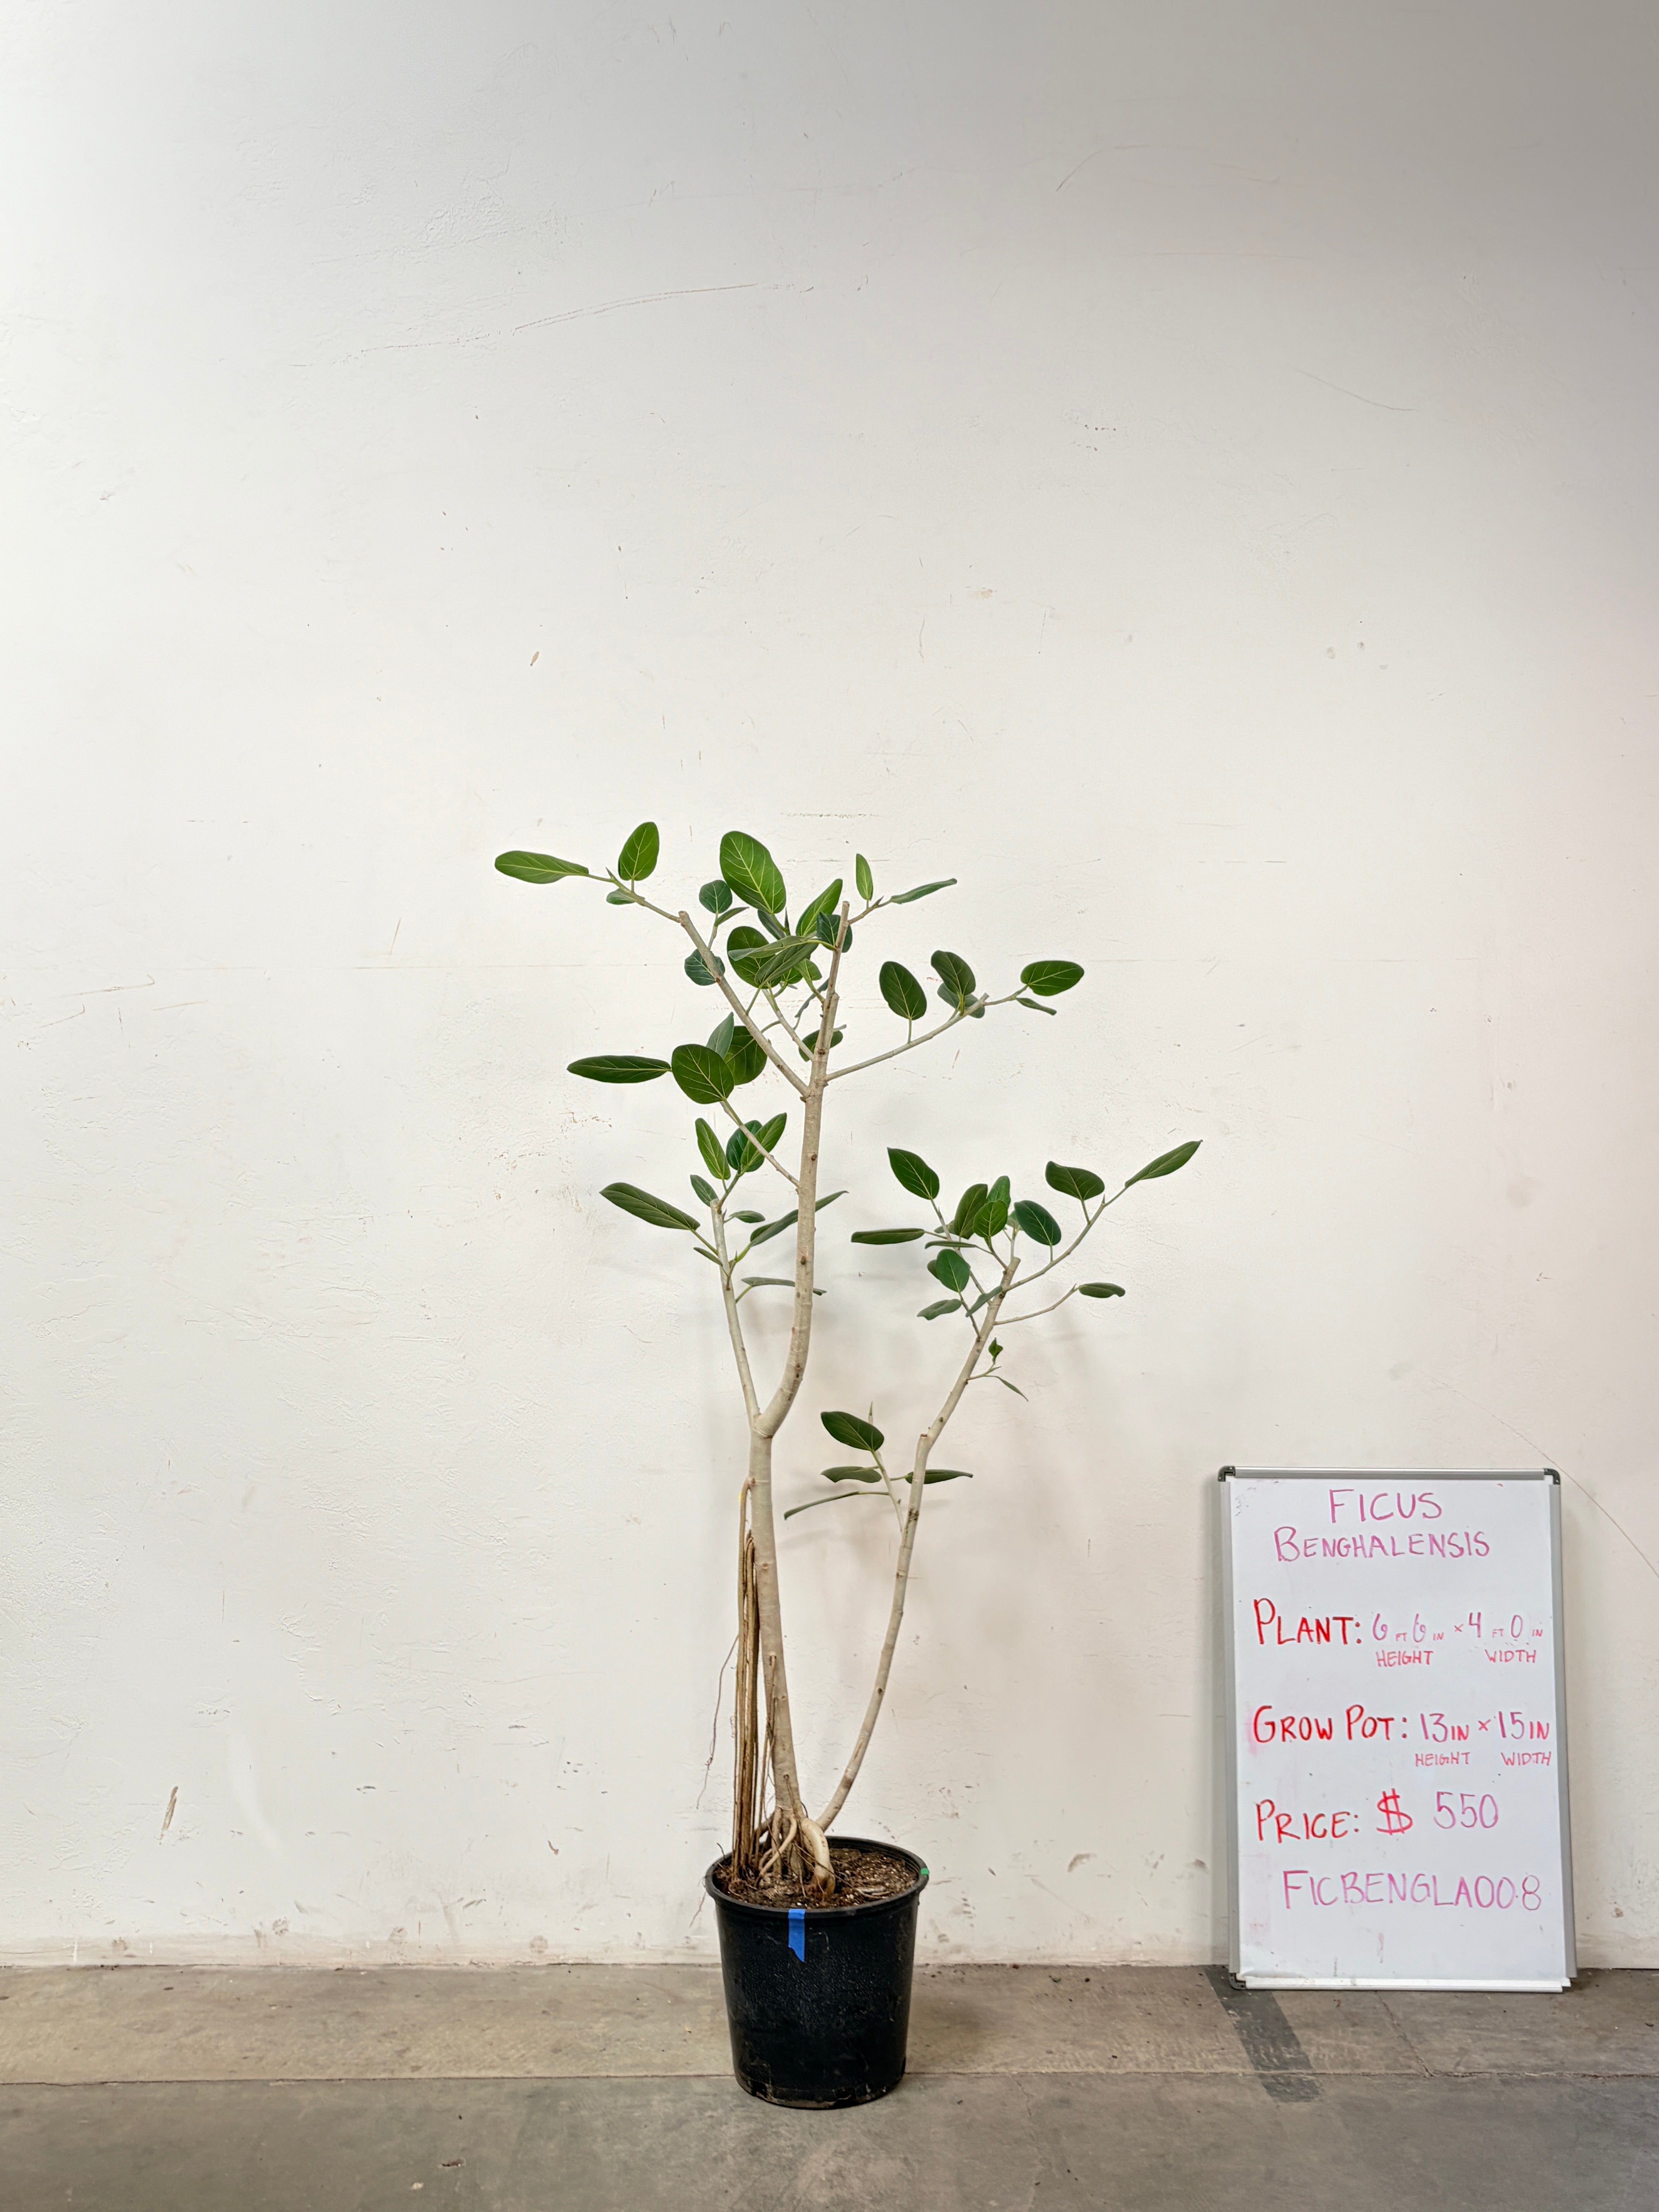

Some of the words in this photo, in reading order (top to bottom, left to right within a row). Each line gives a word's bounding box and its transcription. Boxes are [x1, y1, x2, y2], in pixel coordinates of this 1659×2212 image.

[1329, 1488, 1443, 1524] FICUS
[1273, 1526, 1491, 1562] BENGHALENSIS
[1253, 1598, 1362, 1646] PLANT:
[1372, 1613, 1388, 1641] 6
[1412, 1613, 1427, 1643] 6
[1468, 1611, 1482, 1638] 4
[1375, 1649, 1434, 1668] HEIGHT
[1484, 1649, 1537, 1664] WIDTH
[1252, 1704, 1334, 1743] GROW
[1345, 1704, 1409, 1742] POT:
[1415, 1751, 1471, 1767] HEIGHT
[1500, 1751, 1552, 1767] WIDTH
[1255, 1798, 1359, 1844] PRICE:
[1376, 1788, 1413, 1836] $
[1433, 1790, 1499, 1830] 550
